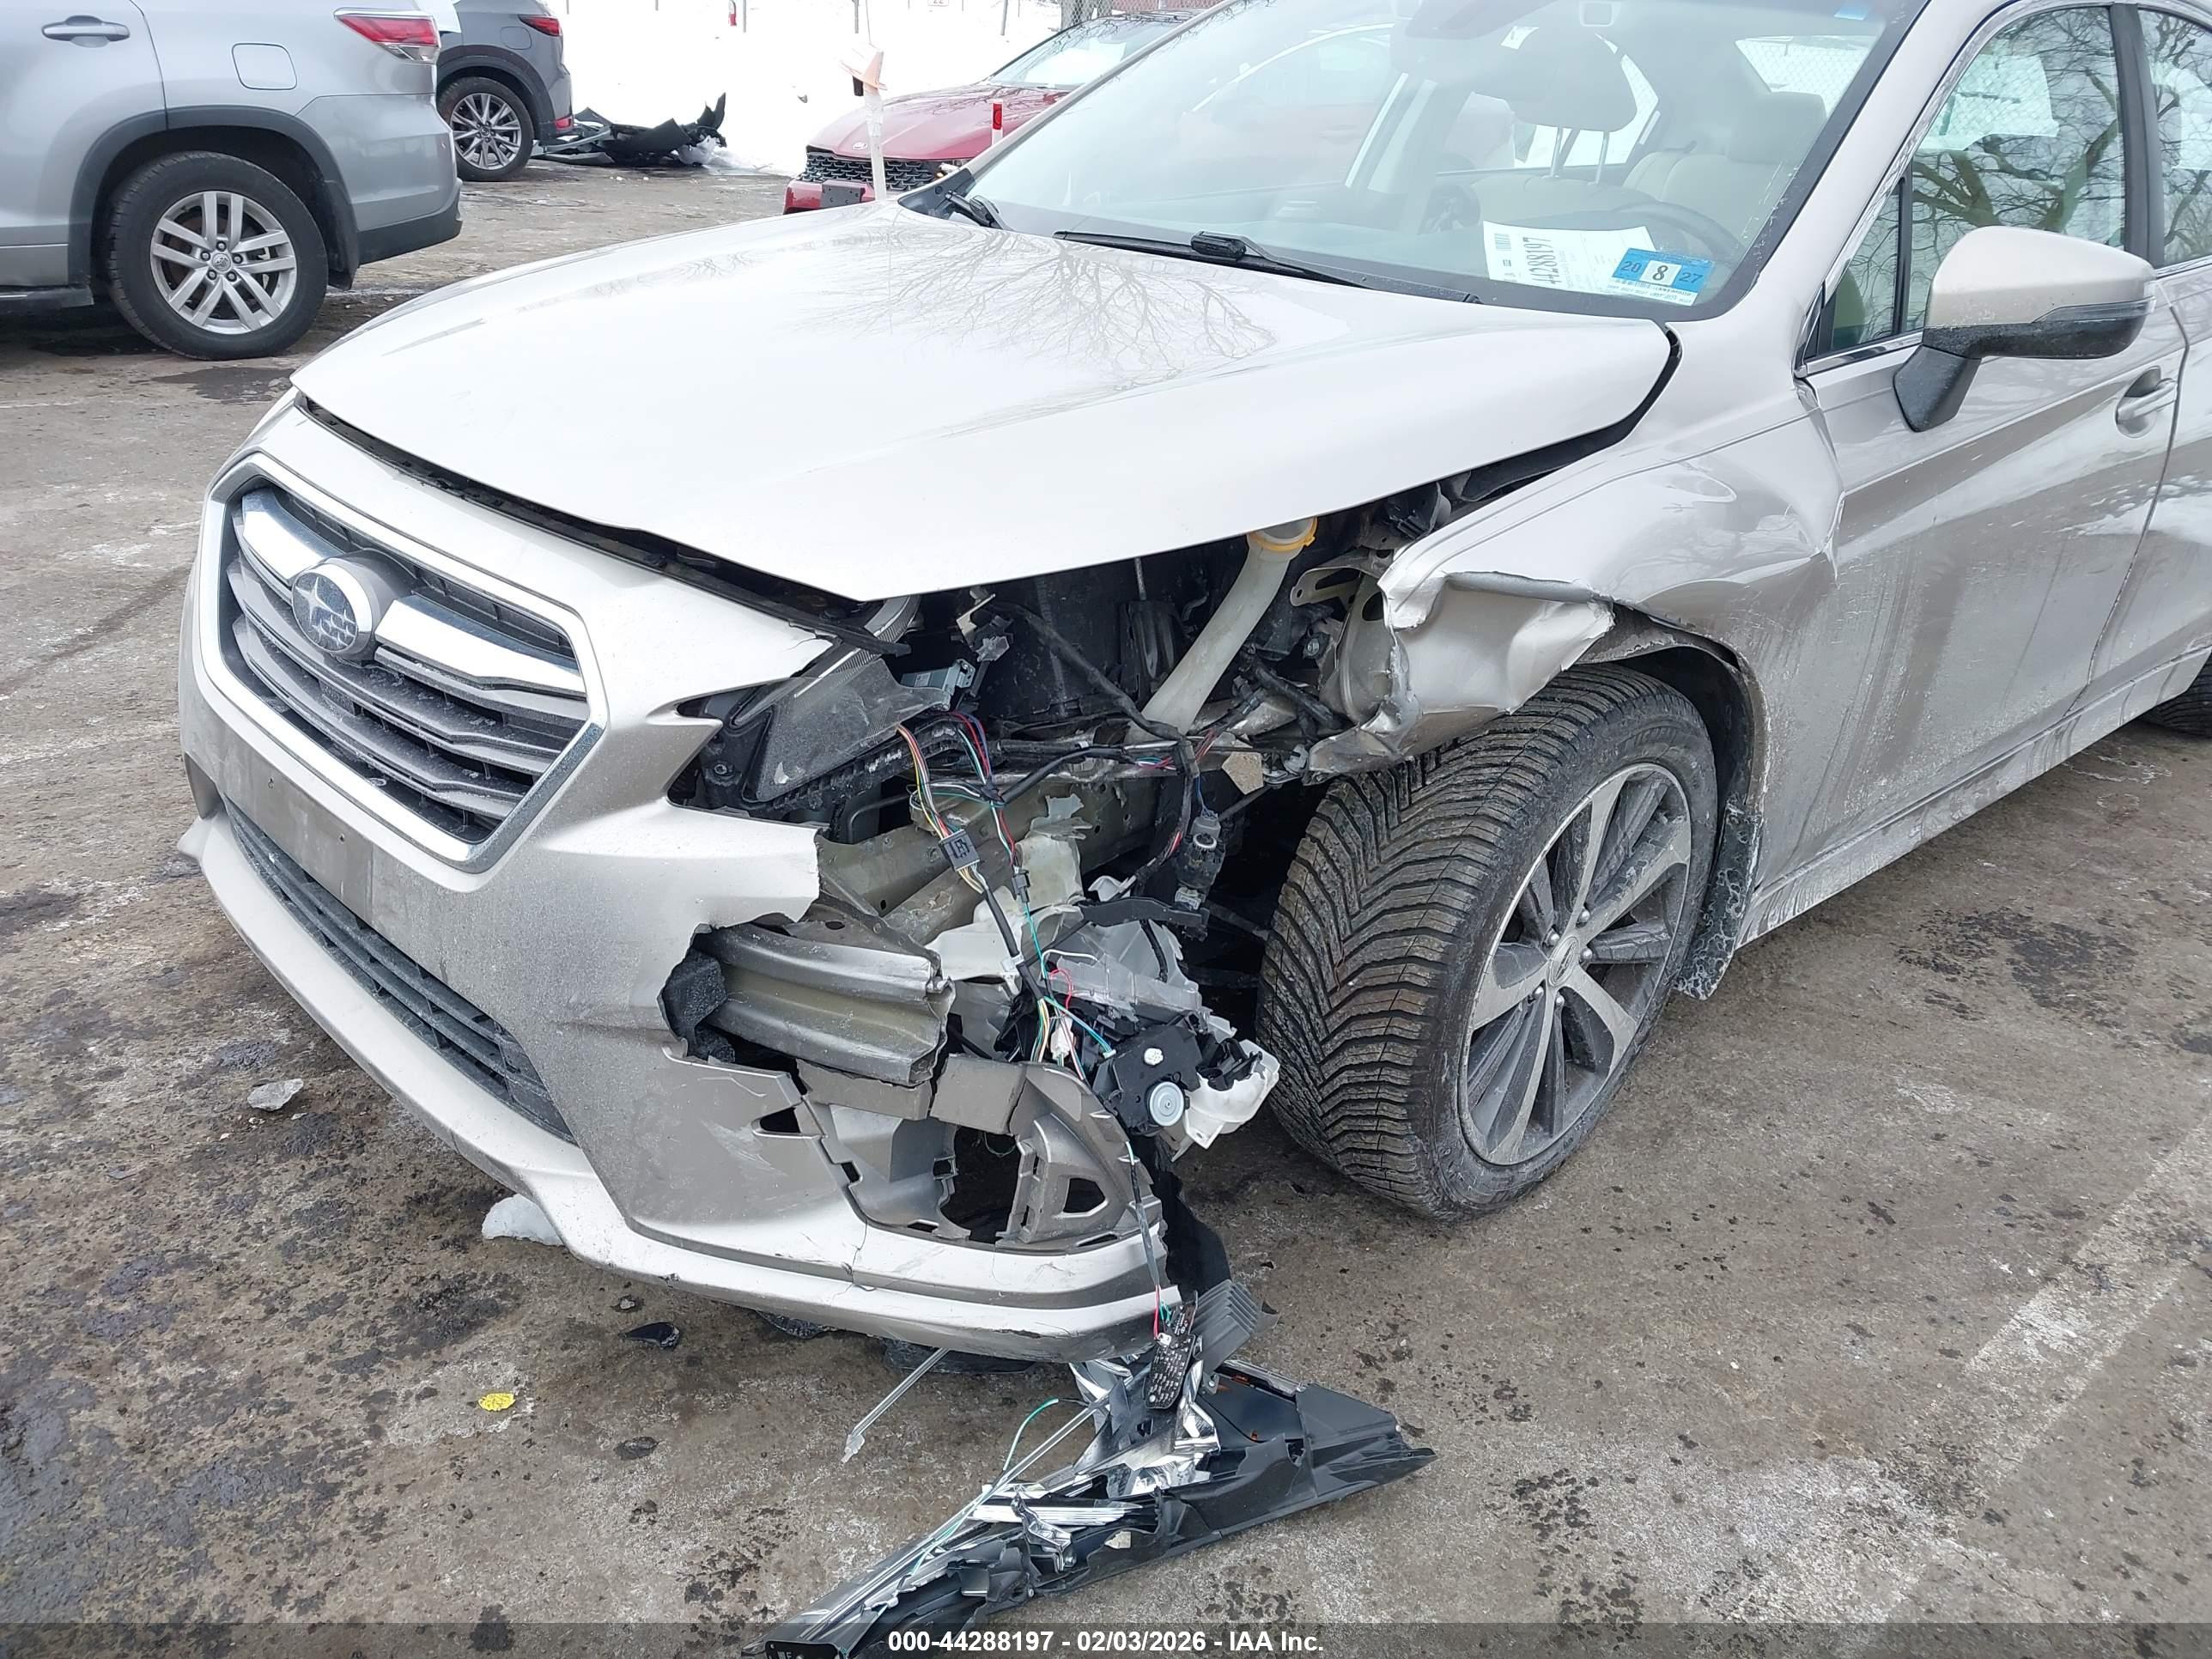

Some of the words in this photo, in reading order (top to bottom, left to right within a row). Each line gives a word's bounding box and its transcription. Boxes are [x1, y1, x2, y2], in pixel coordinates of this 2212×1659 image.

[1523, 236, 1561, 284] 44288197
[1621, 260, 1642, 273] 20
[1651, 264, 1668, 281] 8
[1679, 272, 1703, 283] 27
